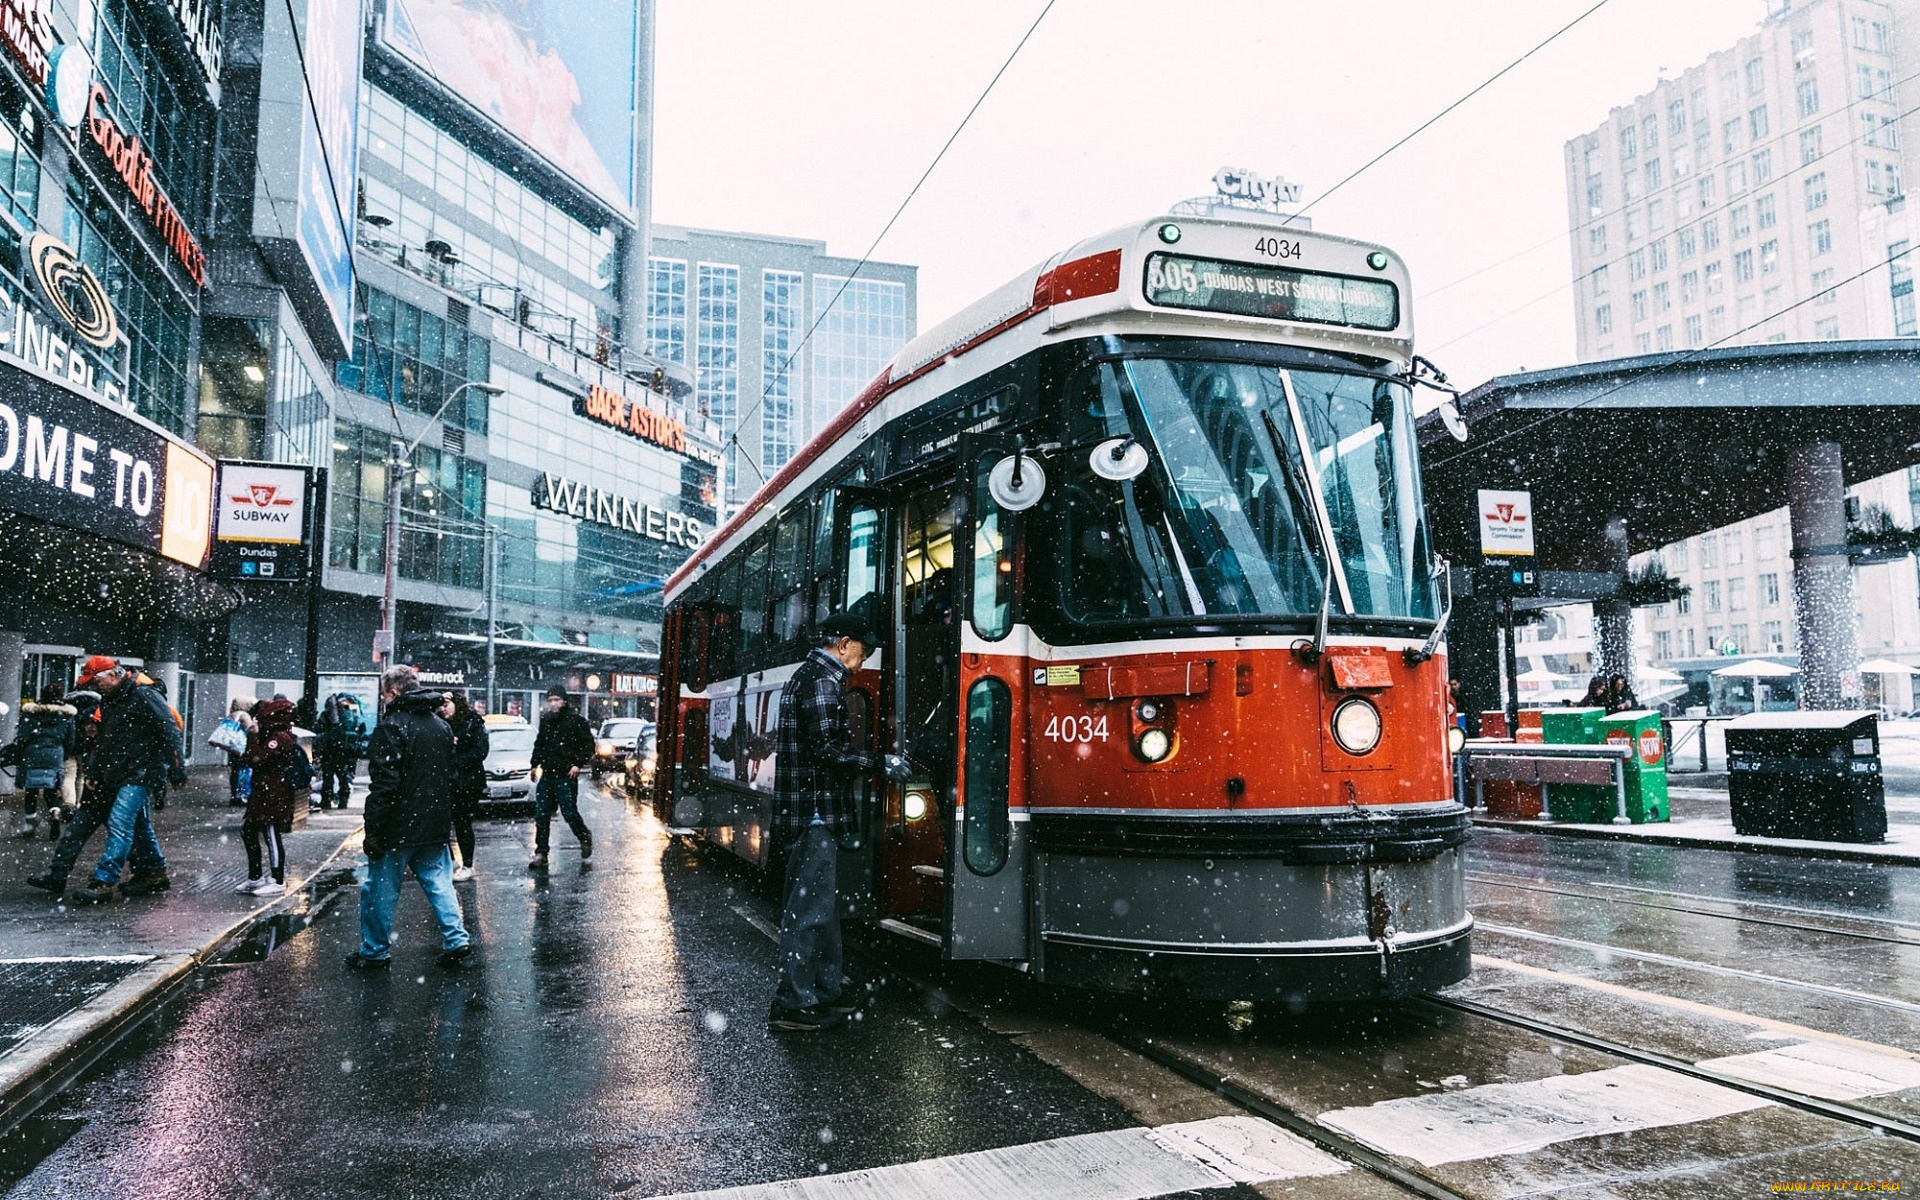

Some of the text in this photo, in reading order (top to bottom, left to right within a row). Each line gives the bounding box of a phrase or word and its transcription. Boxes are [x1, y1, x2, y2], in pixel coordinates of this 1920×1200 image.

[3, 4, 52, 86] MART
[89, 82, 206, 287] GoodLife FITNESS
[1255, 236, 1302, 260] 4034
[1203, 271, 1255, 293] DUNDAS
[1255, 278, 1290, 297] WEST
[586, 384, 627, 429] JACK
[630, 402, 686, 454] ASTOR'S
[110, 447, 154, 517] TO
[233, 509, 290, 523] SUBWAY
[544, 471, 701, 550] WINNERS
[240, 546, 278, 558] Dundas
[1485, 557, 1510, 567] Dundas
[418, 671, 443, 683] wine
[1044, 714, 1110, 743] 4034
[1640, 737, 1661, 757] NOW
